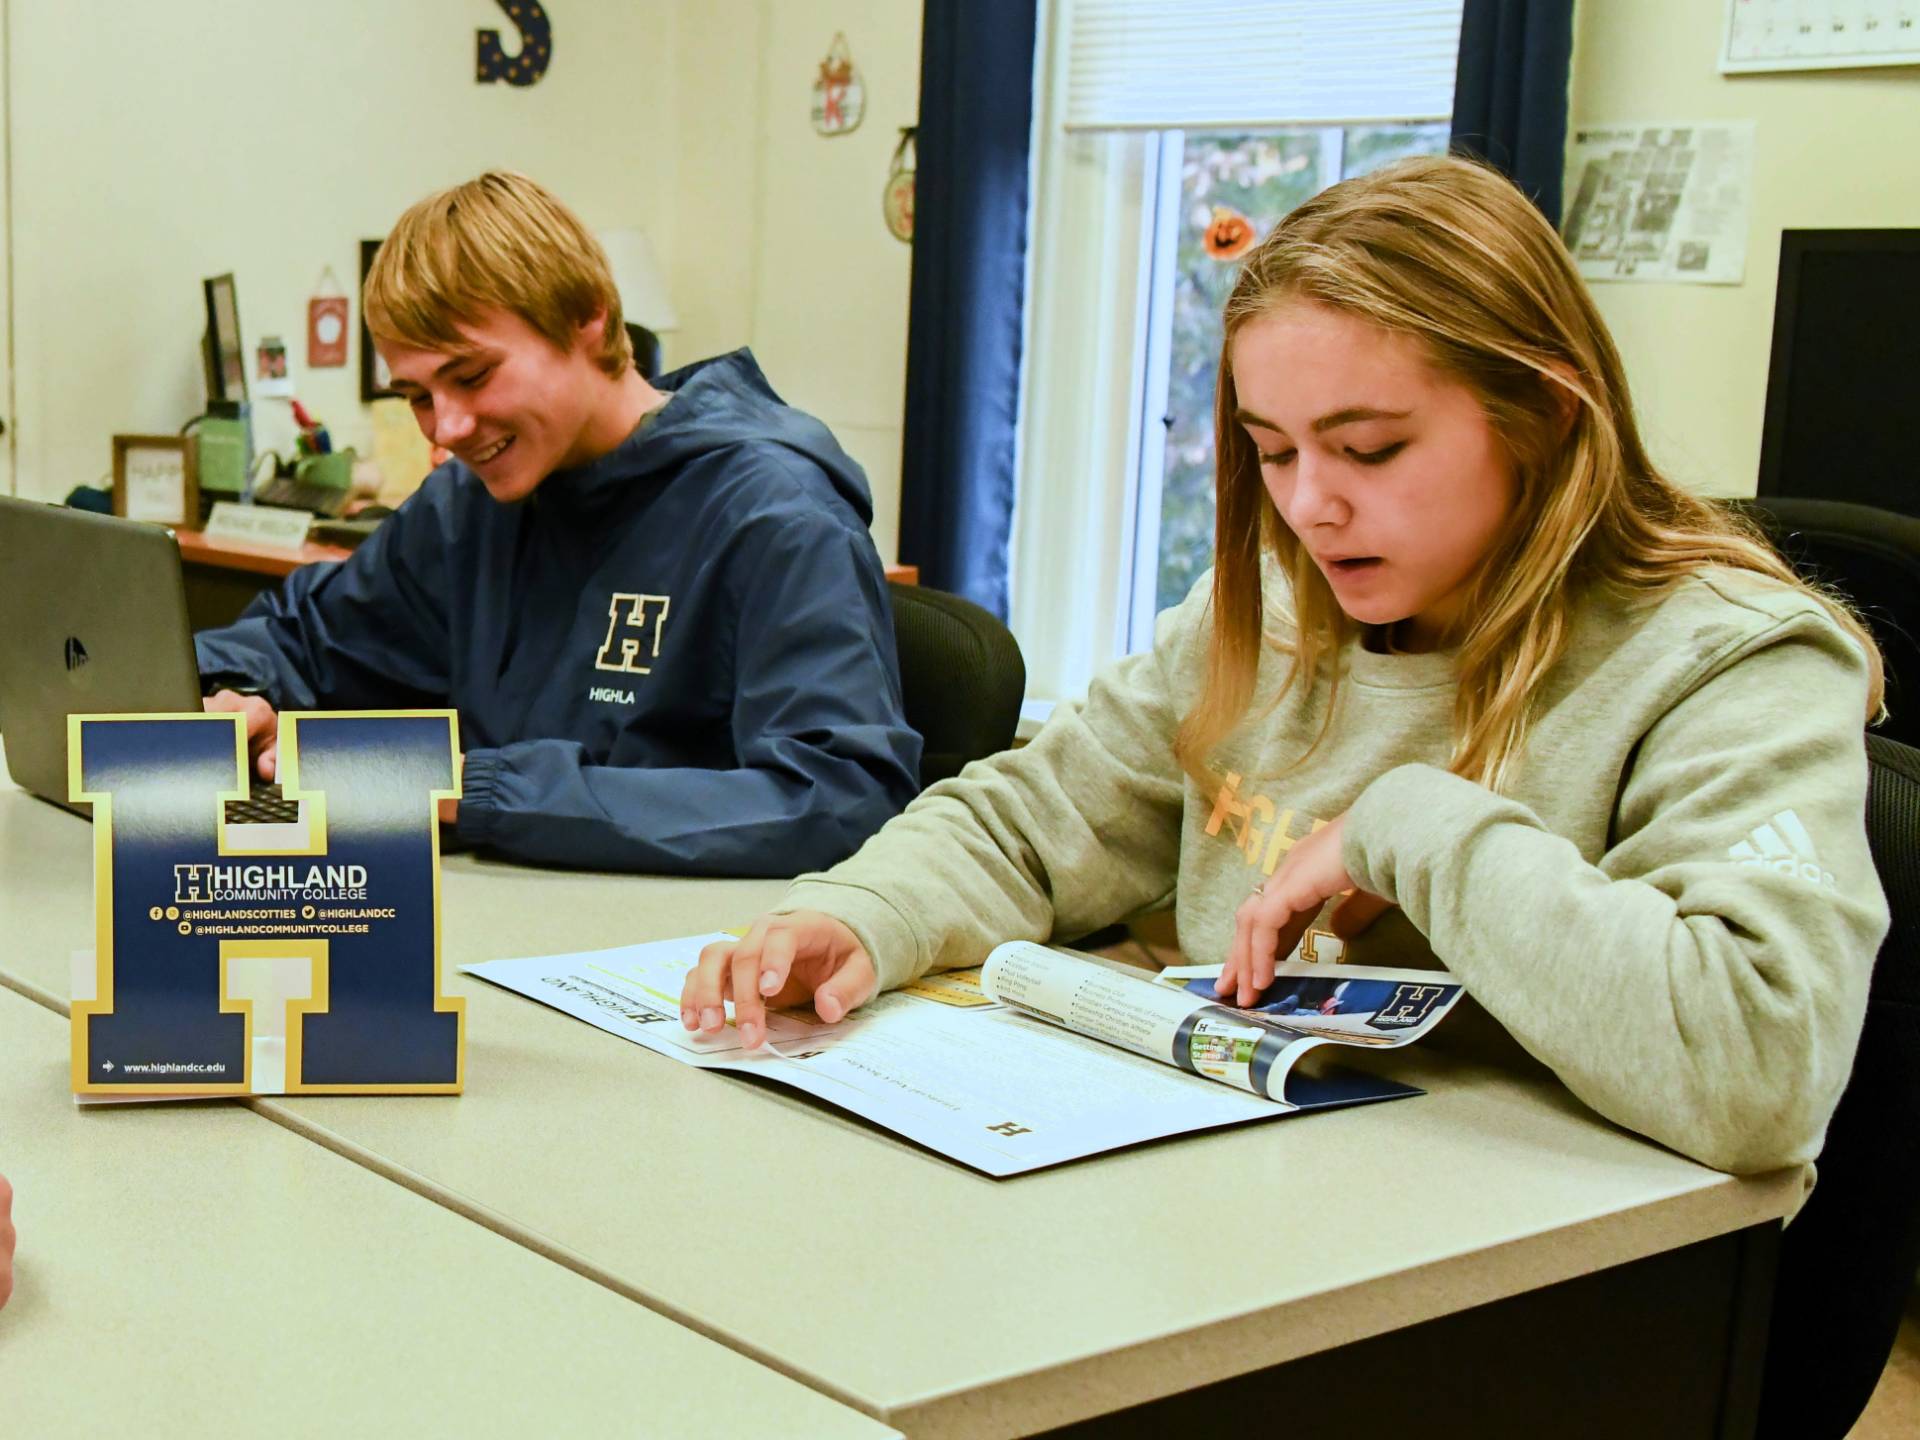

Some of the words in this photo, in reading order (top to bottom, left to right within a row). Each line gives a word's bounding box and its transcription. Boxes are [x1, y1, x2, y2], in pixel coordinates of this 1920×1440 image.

[475, 0, 552, 86] S
[595, 592, 670, 675] H
[589, 687, 635, 704] HIGHLA
[174, 864, 213, 903] H
[214, 865, 367, 889] HIGHLAND
[213, 888, 298, 901] COMMUNITY
[302, 888, 368, 900] COLLEGE
[183, 909, 296, 921] @HIGHLANDSCOTTIES
[318, 908, 396, 920] @HIGHLANDCC
[195, 924, 369, 935] @HIGHLANDCOMMUNITYCOLLEGE
[1379, 984, 1445, 1018] H
[124, 1062, 226, 1073] www.highlandcc.edu
